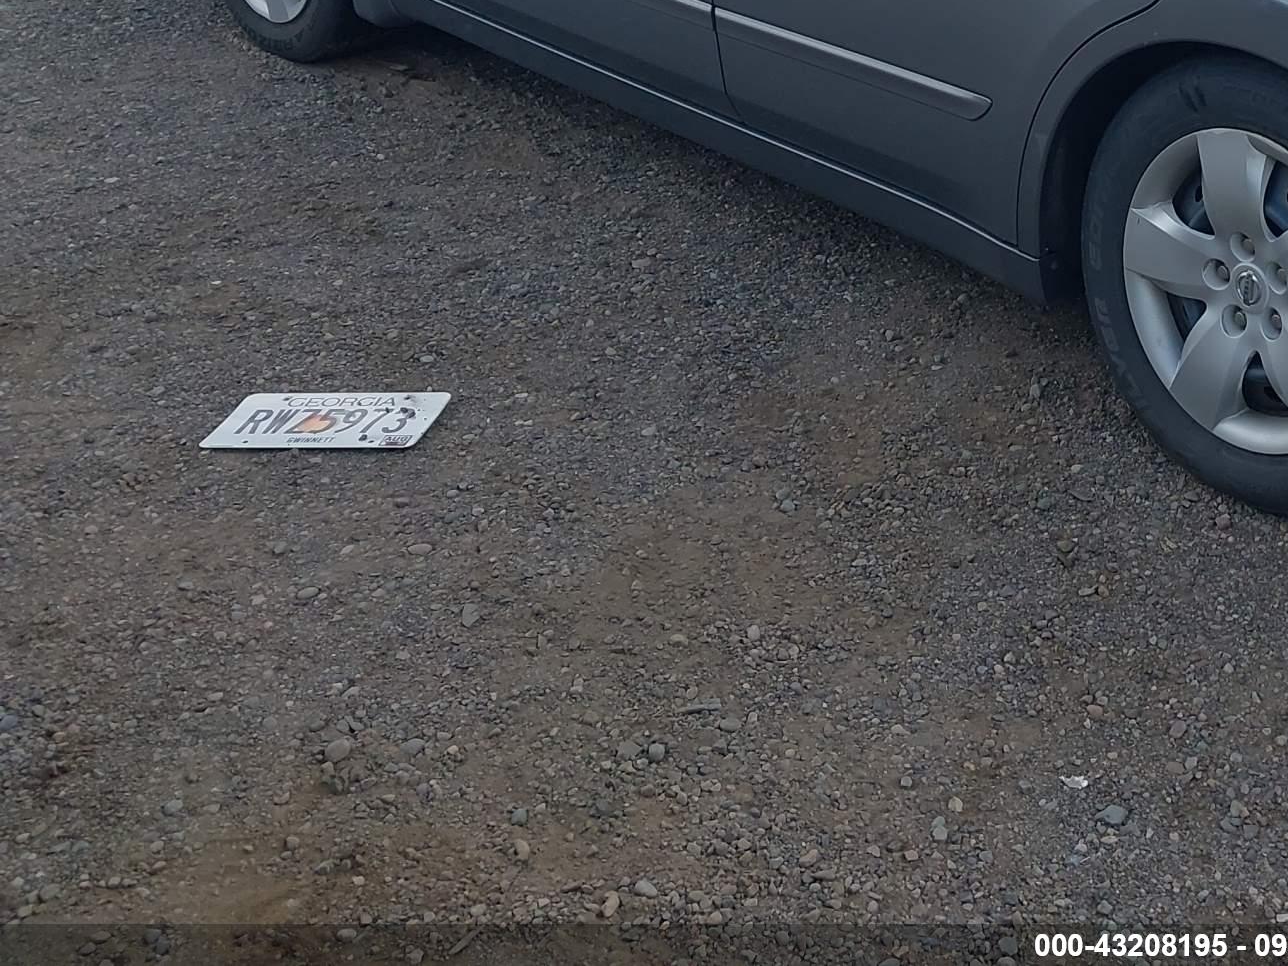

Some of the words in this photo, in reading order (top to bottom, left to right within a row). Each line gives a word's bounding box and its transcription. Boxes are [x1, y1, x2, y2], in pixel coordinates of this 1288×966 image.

[287, 396, 396, 407] GEORGIA
[234, 408, 416, 435] RWZ5973
[286, 436, 336, 444] GWINNETT
